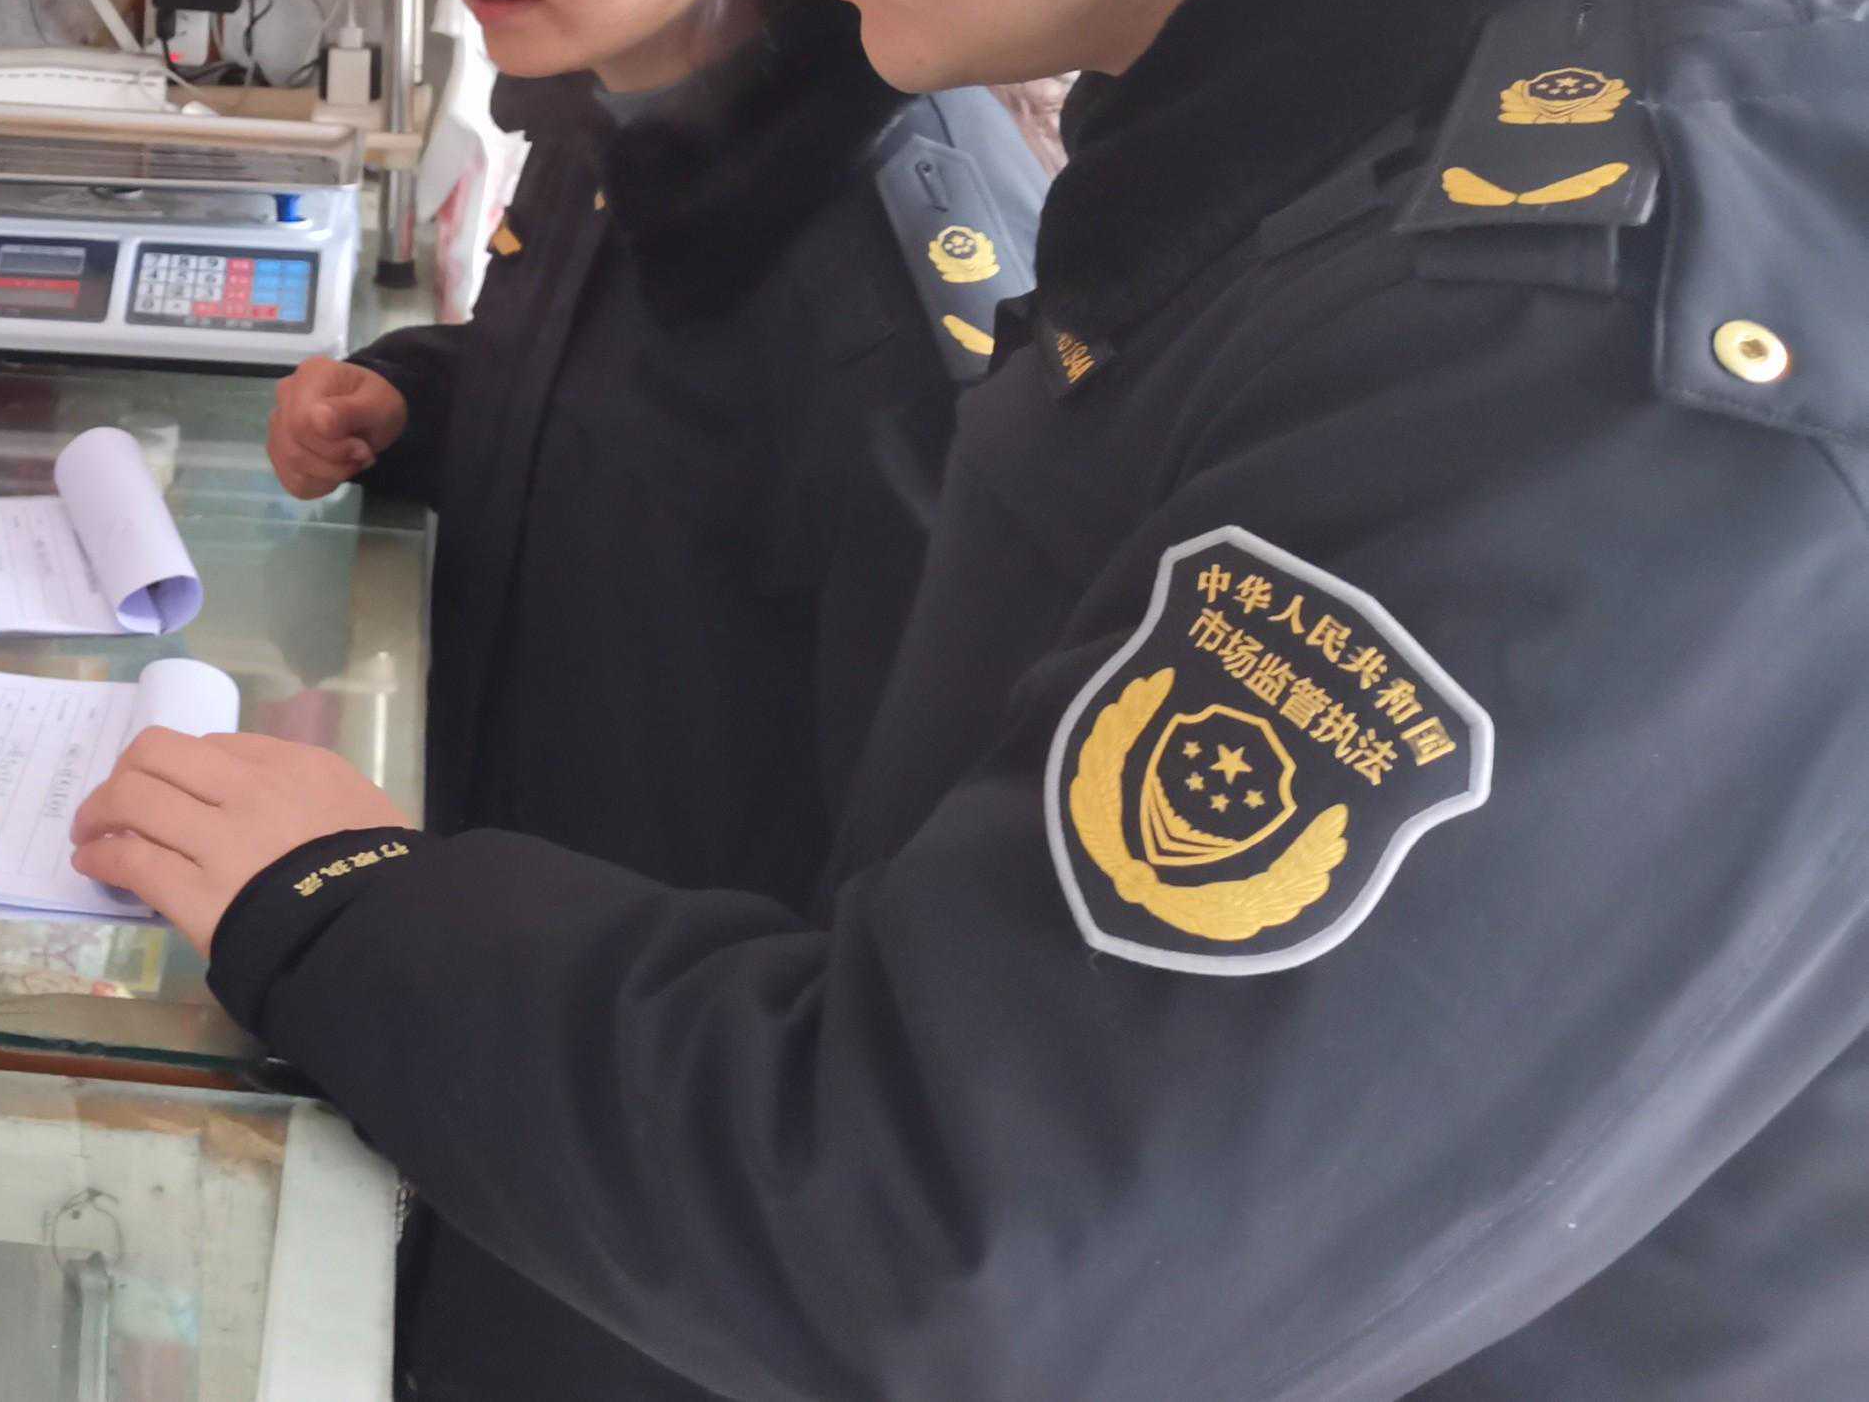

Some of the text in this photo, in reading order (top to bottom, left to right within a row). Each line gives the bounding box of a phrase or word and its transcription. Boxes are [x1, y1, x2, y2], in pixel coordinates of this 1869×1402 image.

[1188, 607, 1398, 786] 市场监管执法
[1197, 563, 1458, 767] 中华人民共和国
